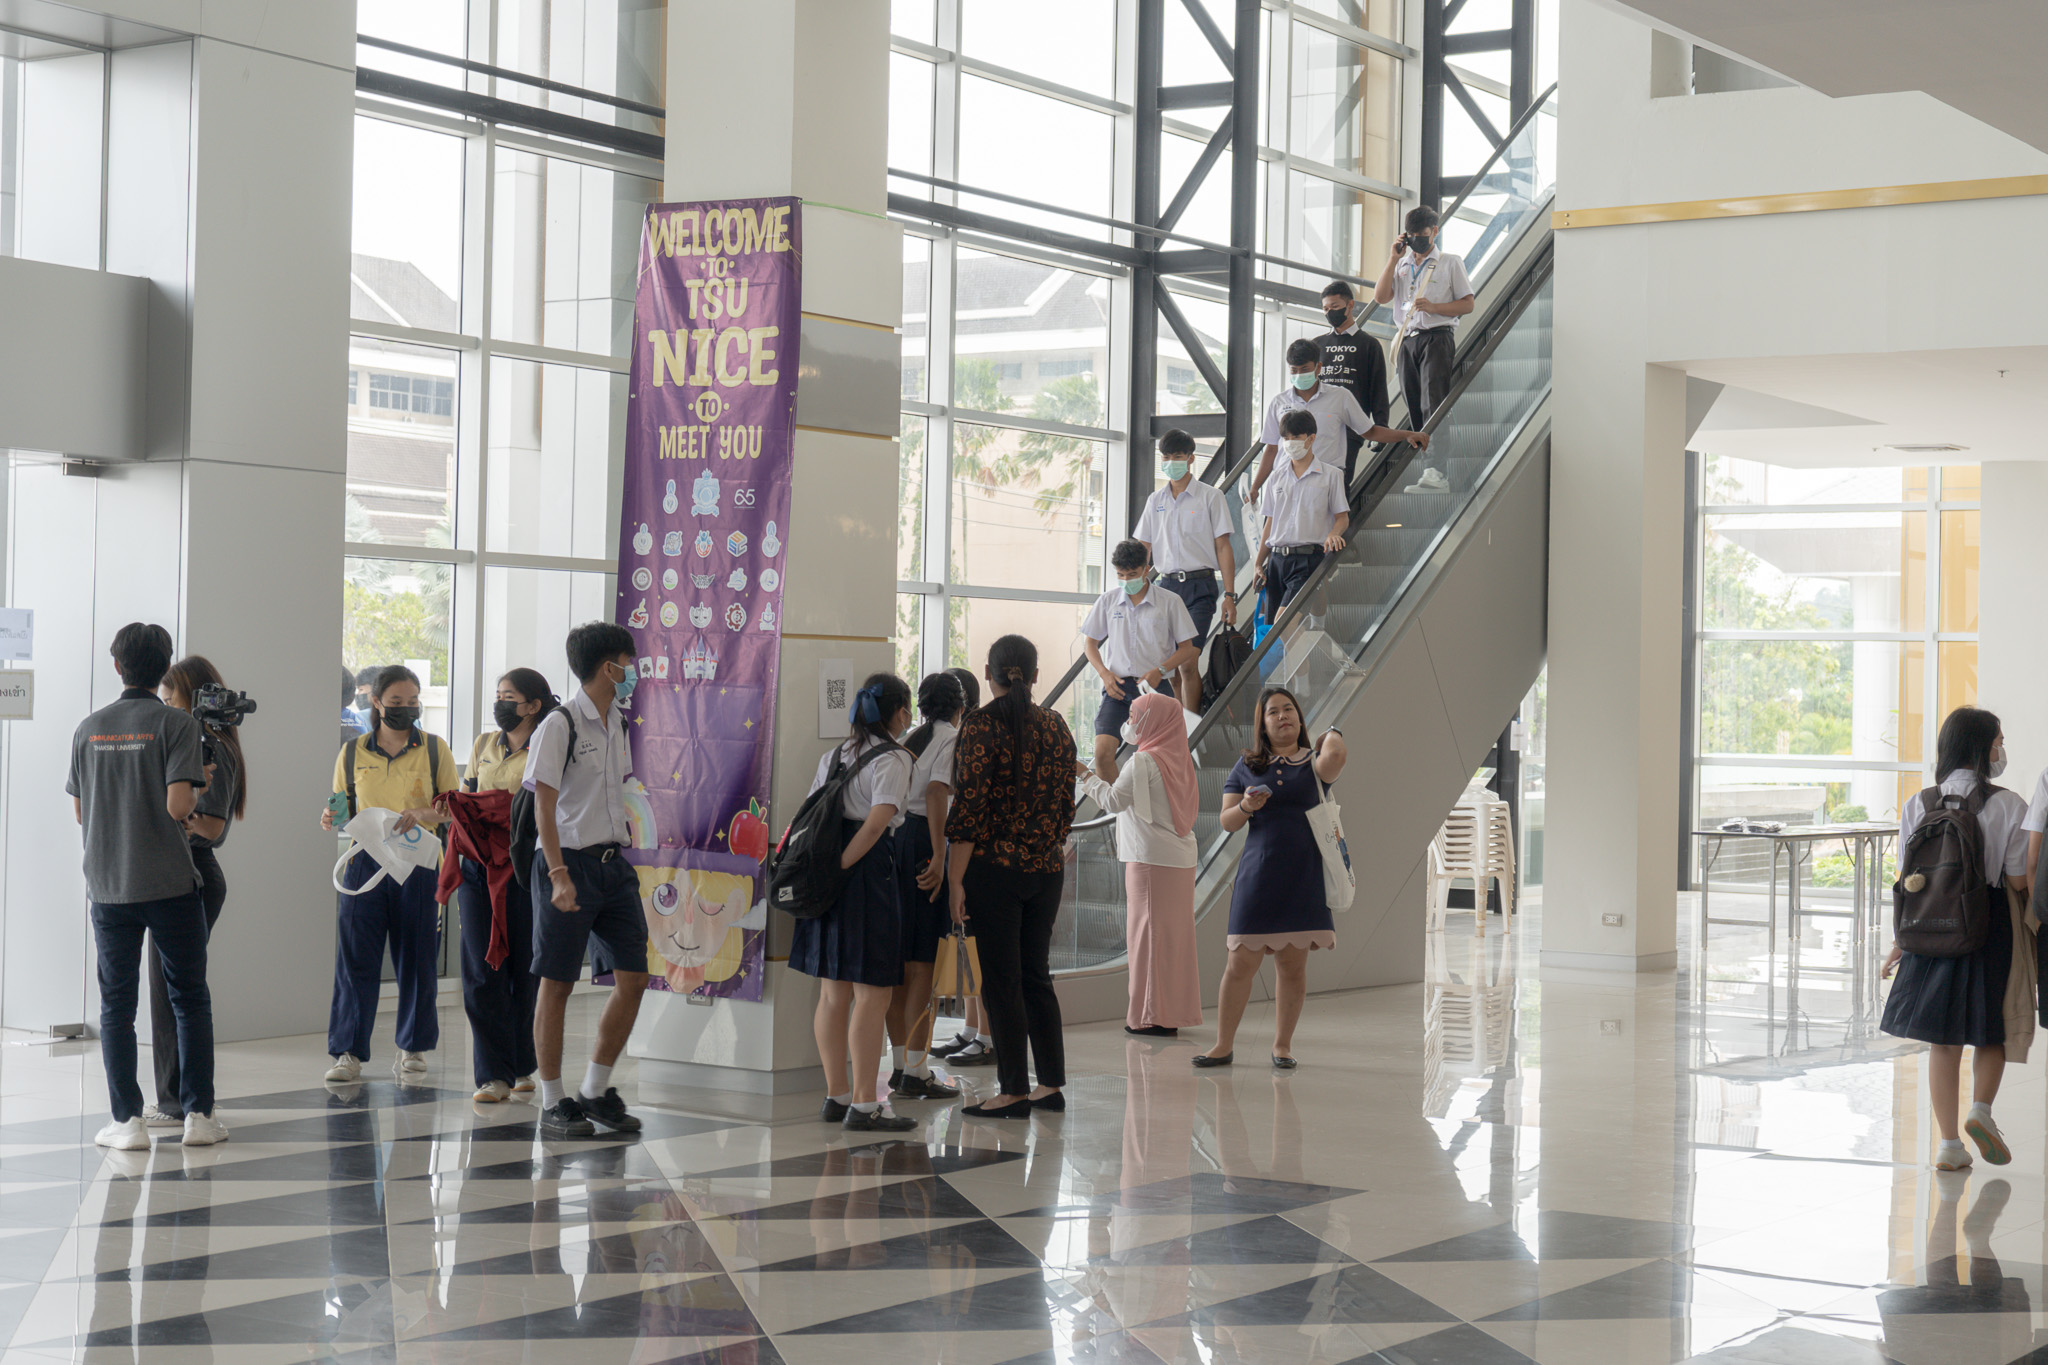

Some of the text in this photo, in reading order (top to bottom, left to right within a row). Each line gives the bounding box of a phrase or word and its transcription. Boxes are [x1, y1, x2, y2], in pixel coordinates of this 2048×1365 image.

[651, 206, 791, 258] WELCOME
[706, 257, 728, 278] TO
[685, 277, 749, 320] TSU
[648, 326, 780, 388] NICE
[1325, 345, 1357, 353] TOKYO
[1332, 354, 1345, 363] JO
[700, 400, 719, 417] TO
[659, 424, 763, 460] MEET YOU
[734, 488, 756, 506] 65
[136, 732, 155, 741] ARTS
[116, 743, 146, 752] UNIVERSITY
